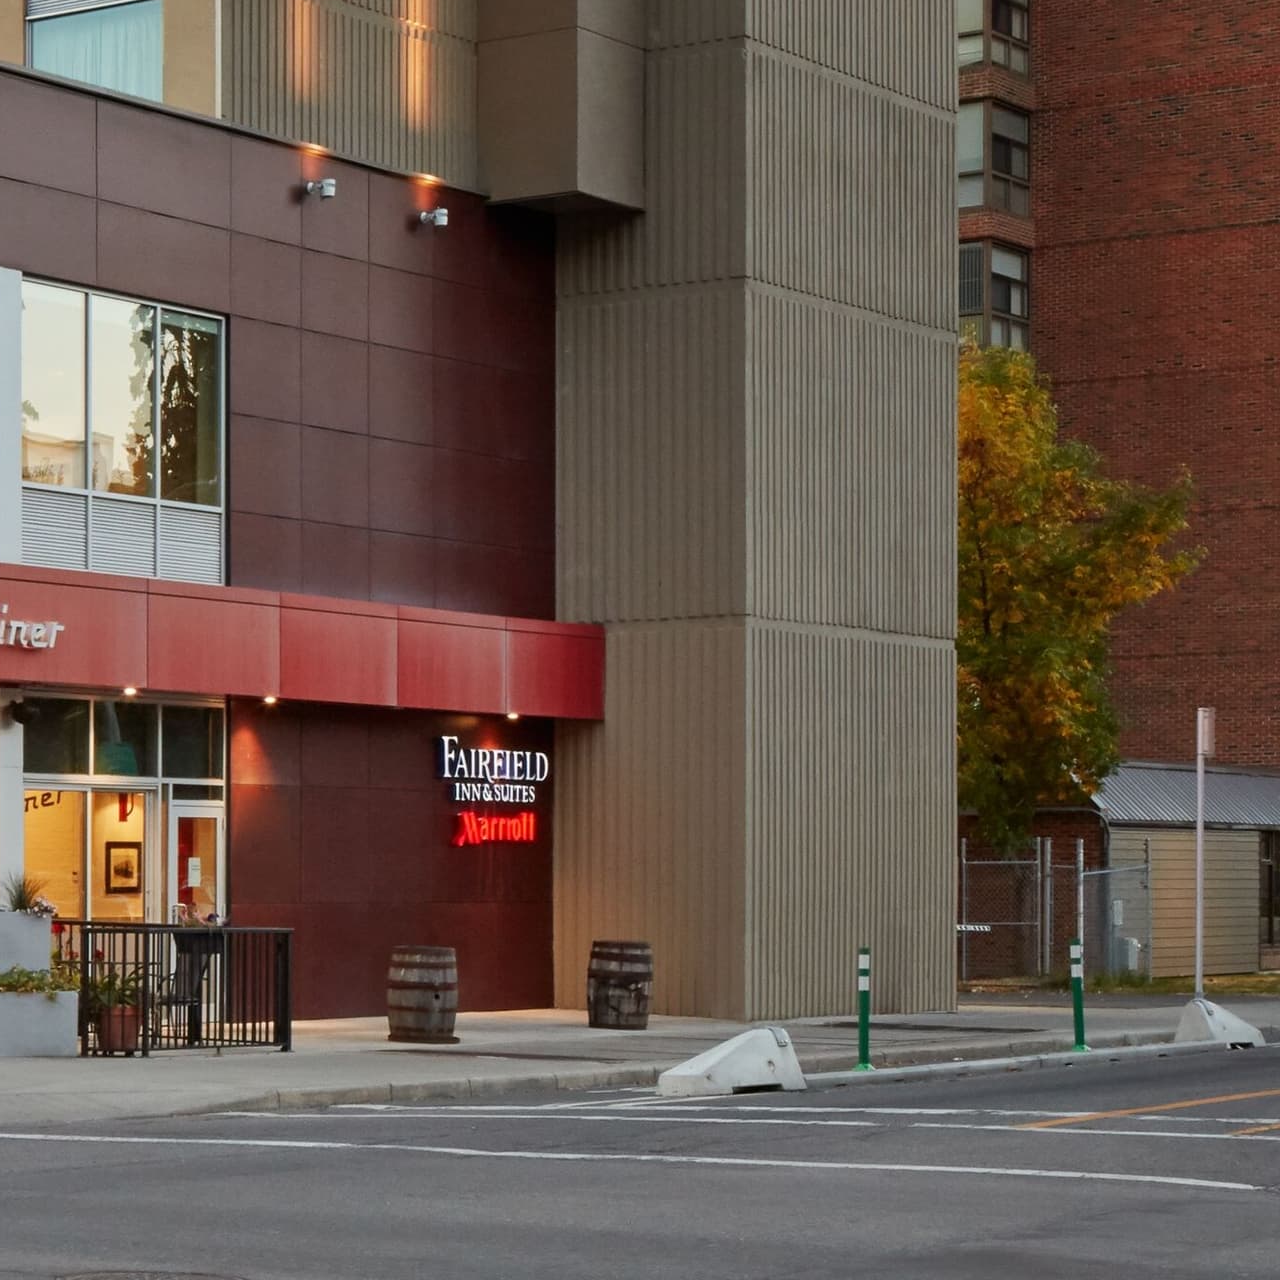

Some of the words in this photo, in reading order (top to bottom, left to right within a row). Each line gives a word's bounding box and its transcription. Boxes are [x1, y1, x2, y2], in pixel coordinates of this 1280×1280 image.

[441, 735, 549, 784] FAIRFIELD
[454, 782, 481, 802] INN
[493, 784, 536, 803] SUITES
[453, 811, 536, 846] Marriott
